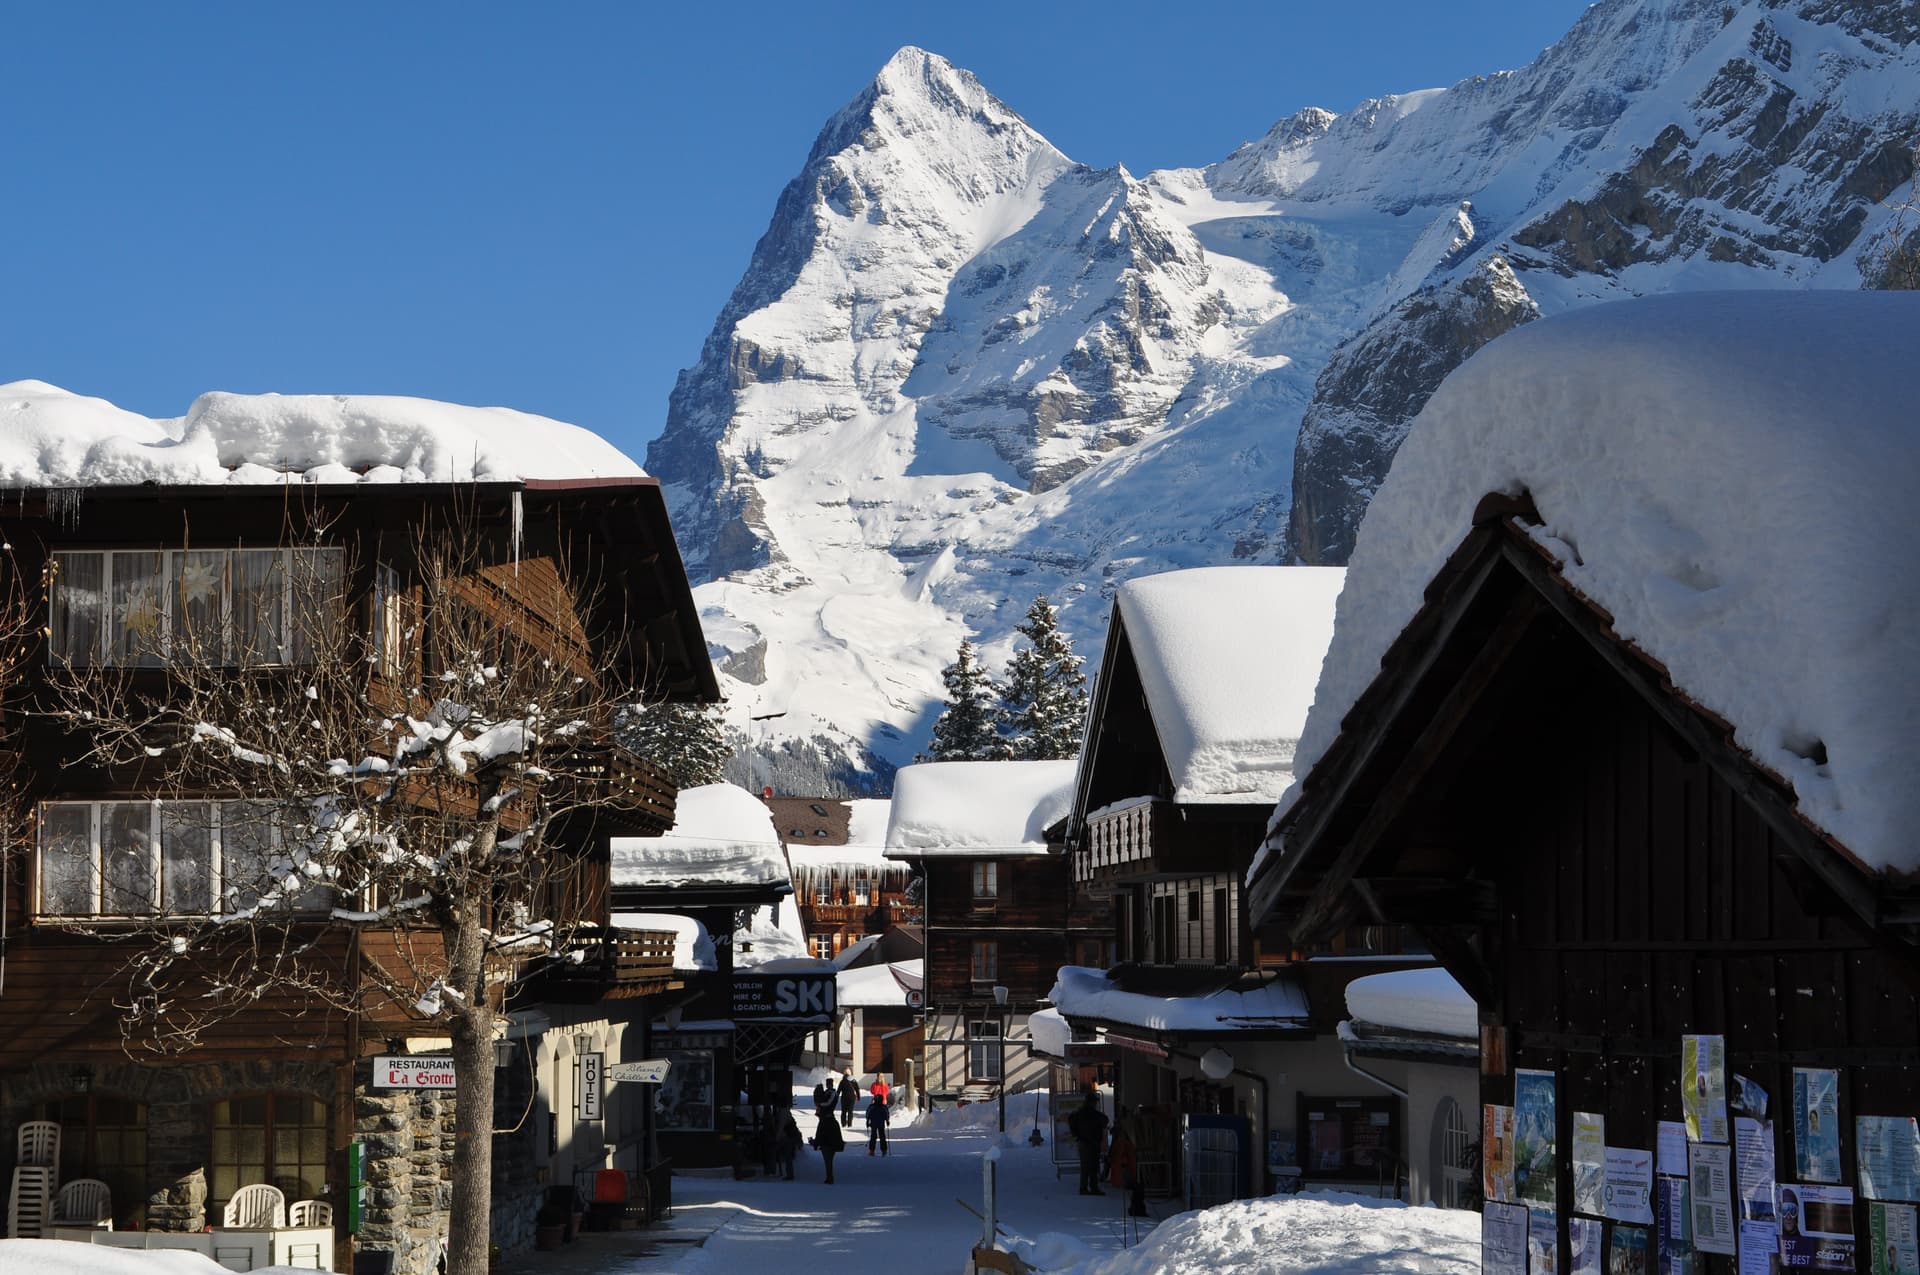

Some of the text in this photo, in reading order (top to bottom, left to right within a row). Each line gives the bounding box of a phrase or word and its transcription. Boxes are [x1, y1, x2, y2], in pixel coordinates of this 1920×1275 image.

[775, 979, 834, 1013] SKI
[389, 1060, 455, 1069] RESTAURANT
[389, 1070, 408, 1084] La
[585, 1059, 596, 1115] HOTEL
[1792, 1255, 1810, 1265] BEST
[1815, 1249, 1845, 1261] station
